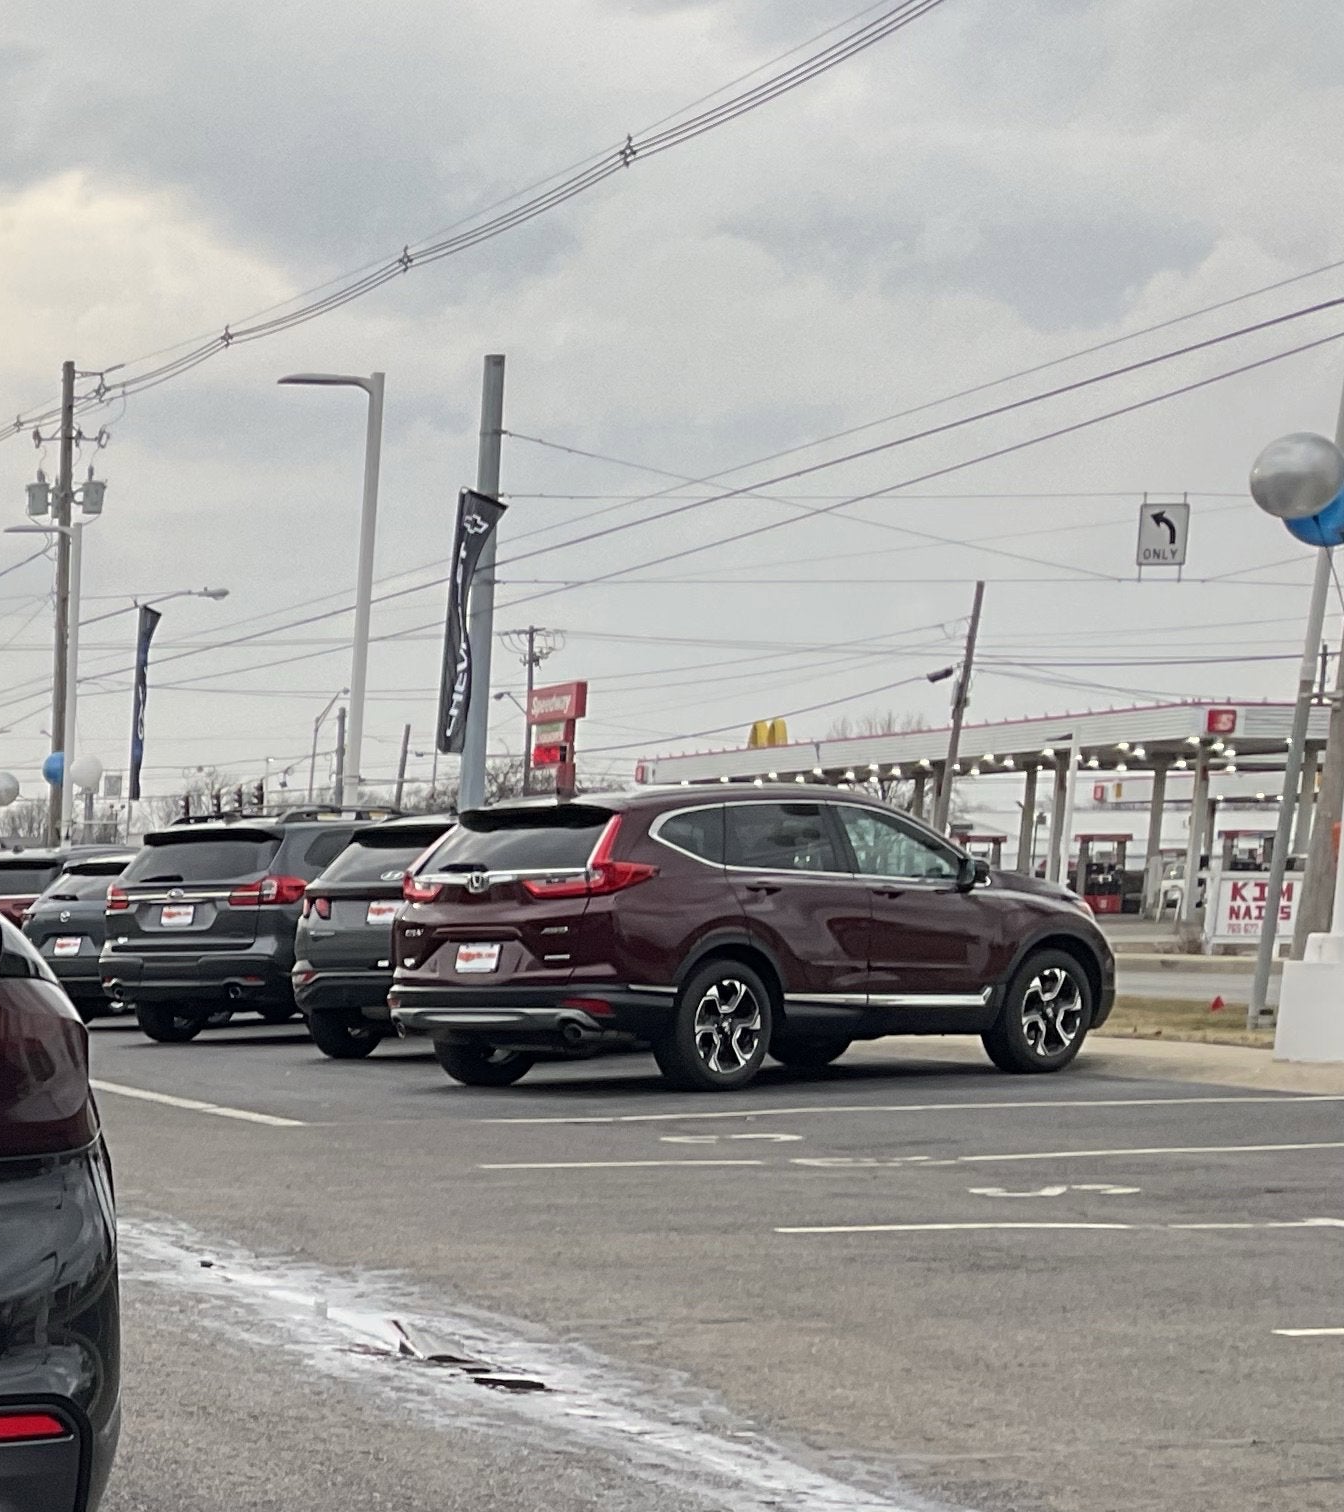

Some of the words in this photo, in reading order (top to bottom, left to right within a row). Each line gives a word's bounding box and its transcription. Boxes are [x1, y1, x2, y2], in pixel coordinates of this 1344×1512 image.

[1143, 548, 1179, 561] ONLY
[1231, 881, 1294, 902] KIM
[1229, 905, 1292, 921] NAIS
